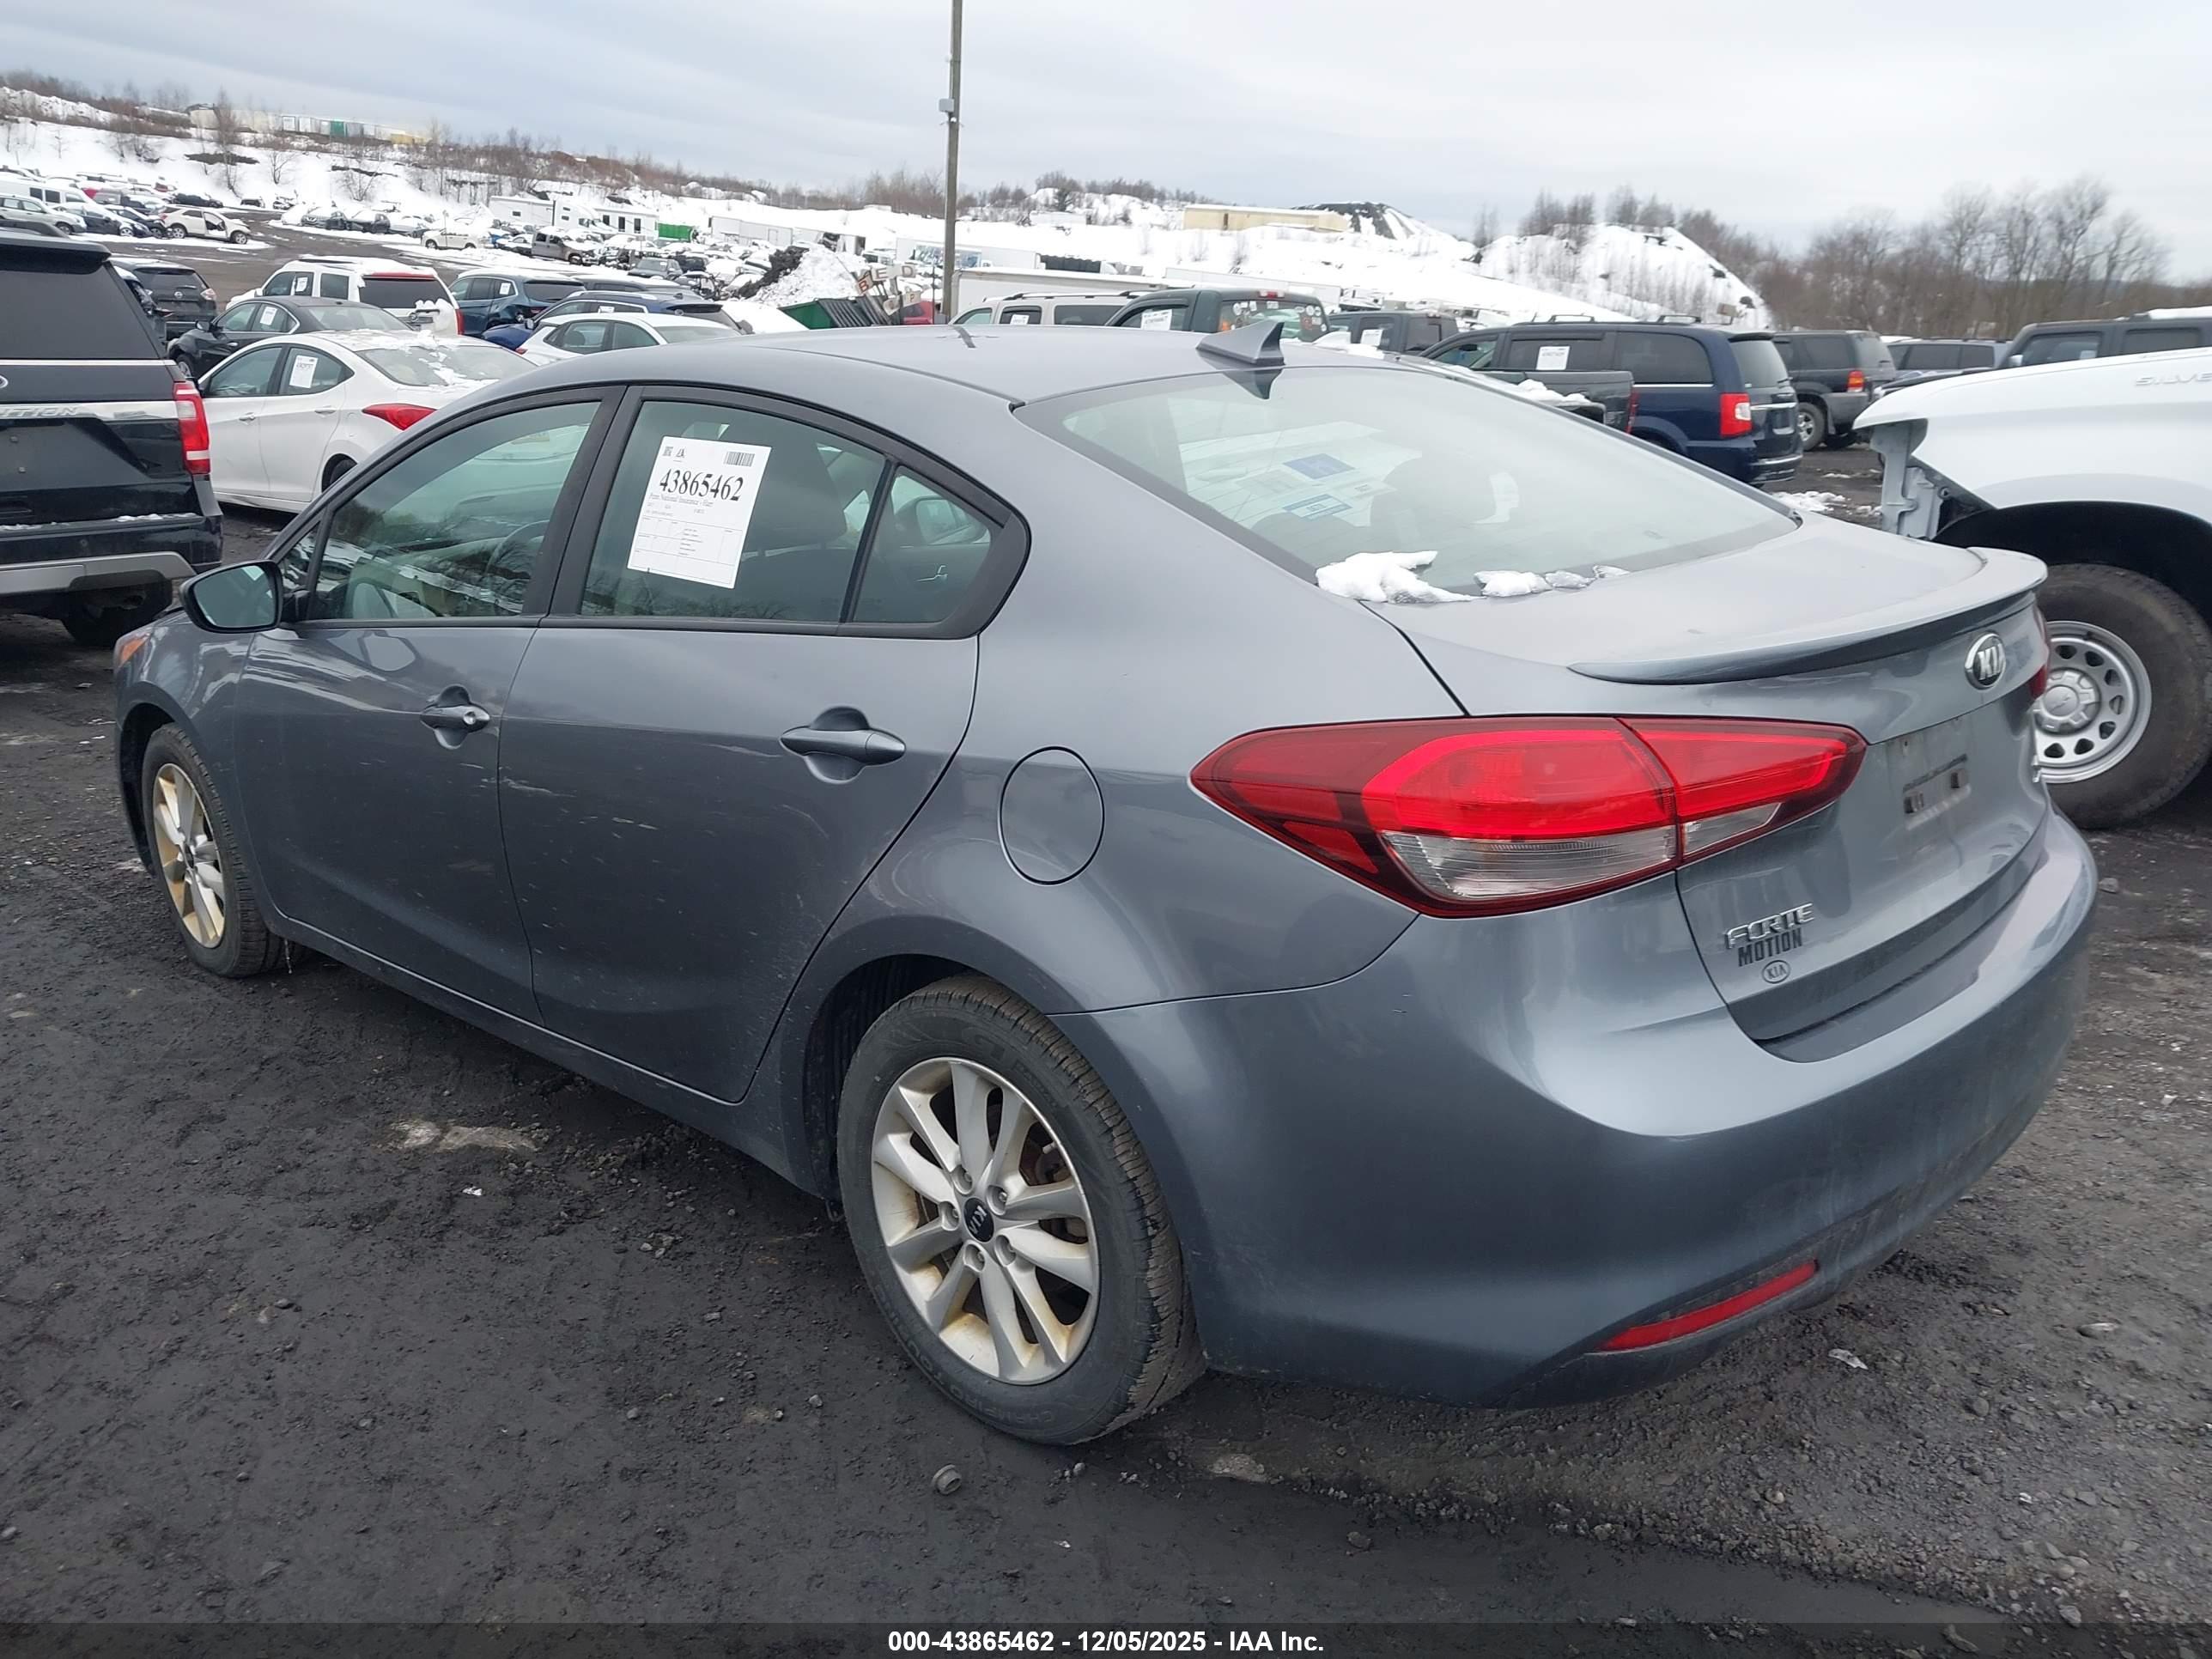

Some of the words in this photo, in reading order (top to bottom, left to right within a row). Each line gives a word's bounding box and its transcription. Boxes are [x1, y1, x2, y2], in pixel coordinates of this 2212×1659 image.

[659, 469, 744, 501] 43865462
[1977, 643, 2006, 681] KIA
[1726, 902, 1814, 949] FORTE
[1738, 927, 1803, 967] MOTION
[1765, 964, 1787, 980] KIA
[968, 1205, 988, 1235] KIA
